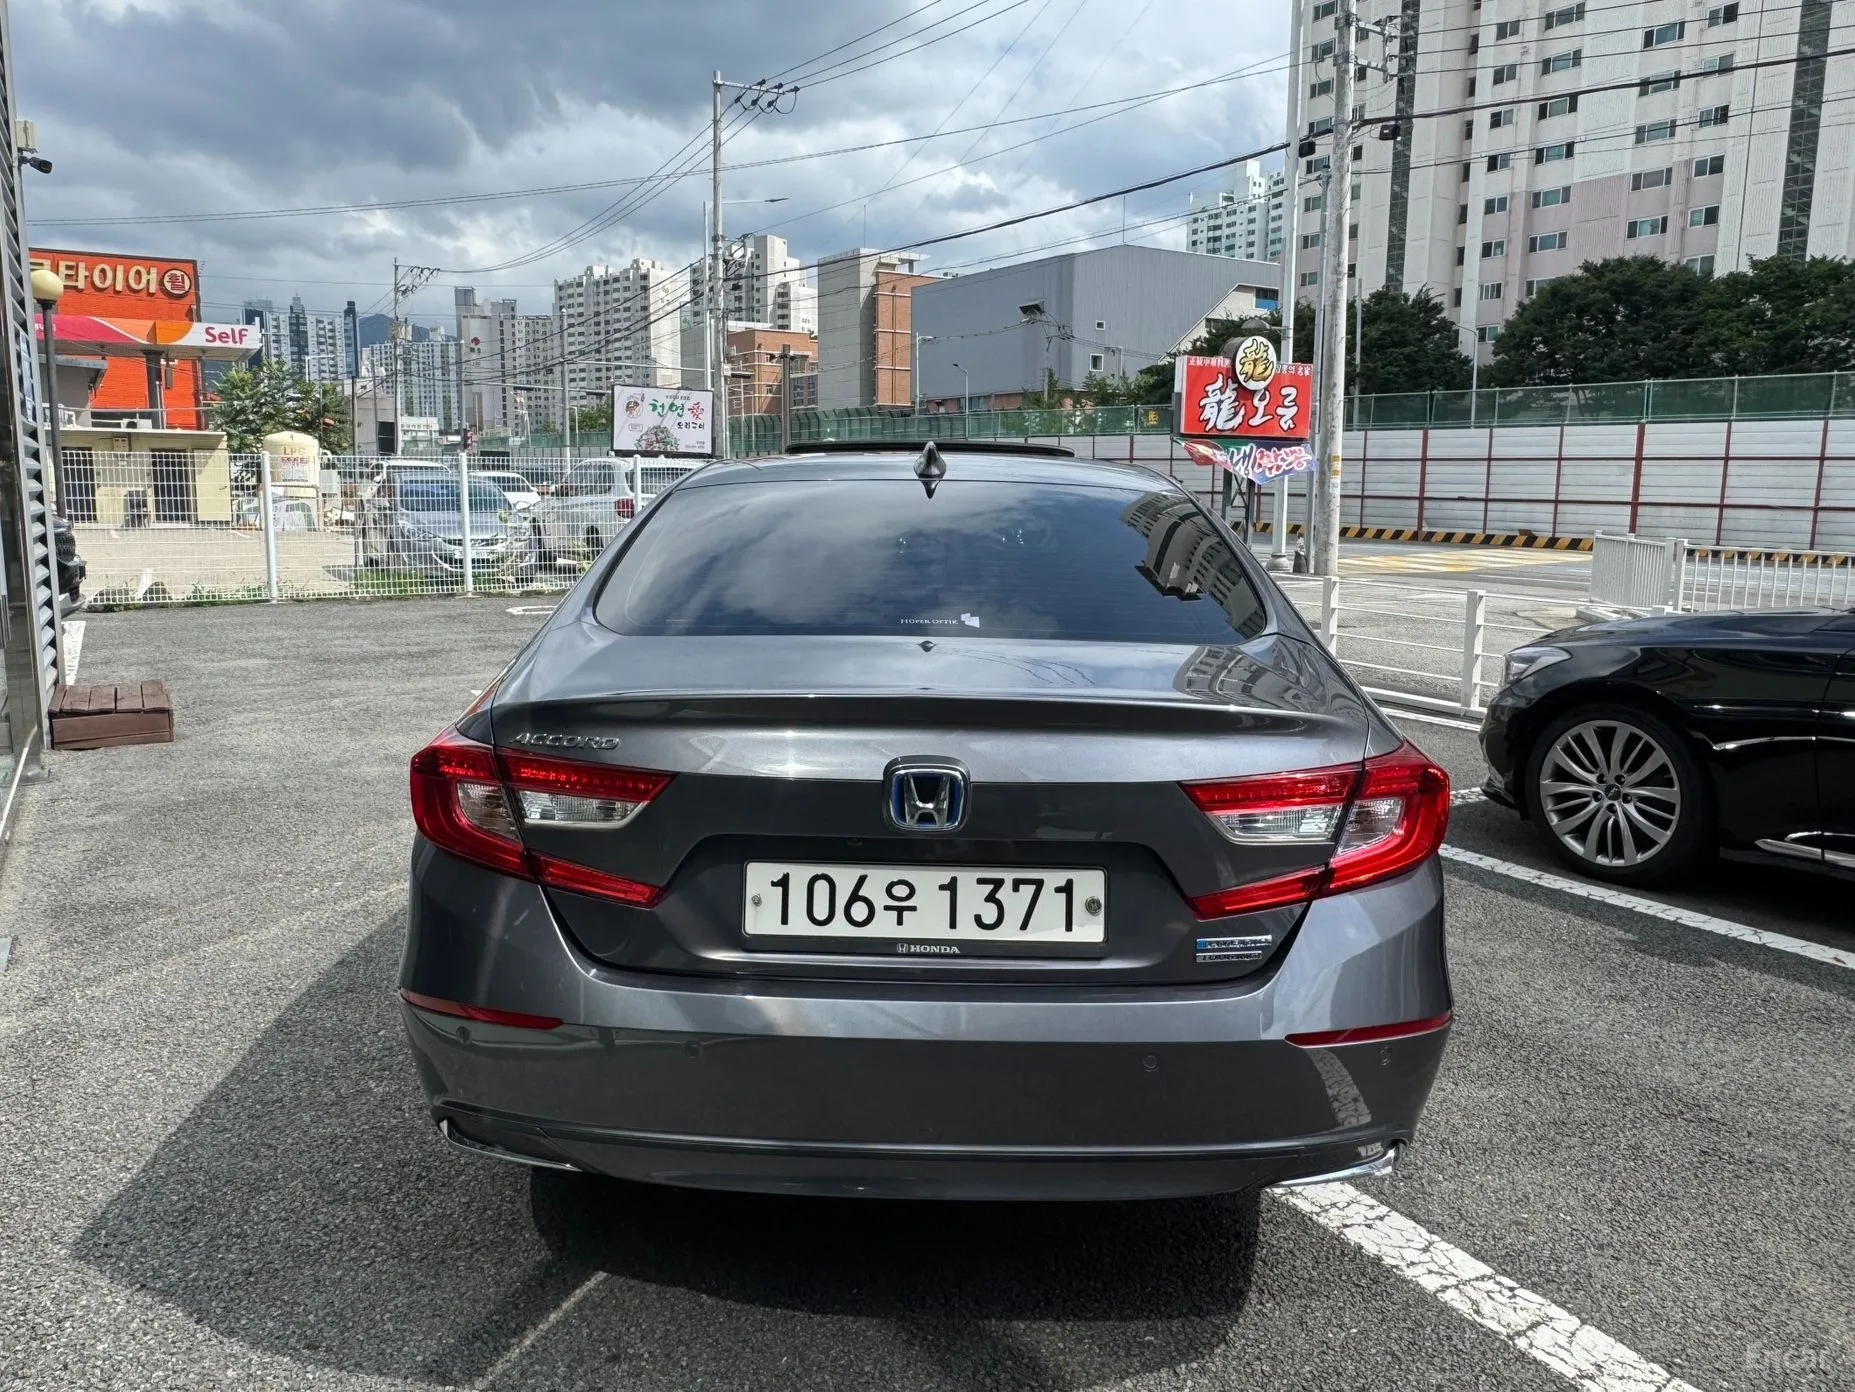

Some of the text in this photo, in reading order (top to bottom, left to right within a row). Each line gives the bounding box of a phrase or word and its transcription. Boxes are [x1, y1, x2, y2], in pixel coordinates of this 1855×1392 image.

[204, 326, 249, 345] Self
[510, 732, 620, 750] ACCORD
[770, 872, 1074, 932] 106우 1371
[909, 944, 961, 954] HONDA
